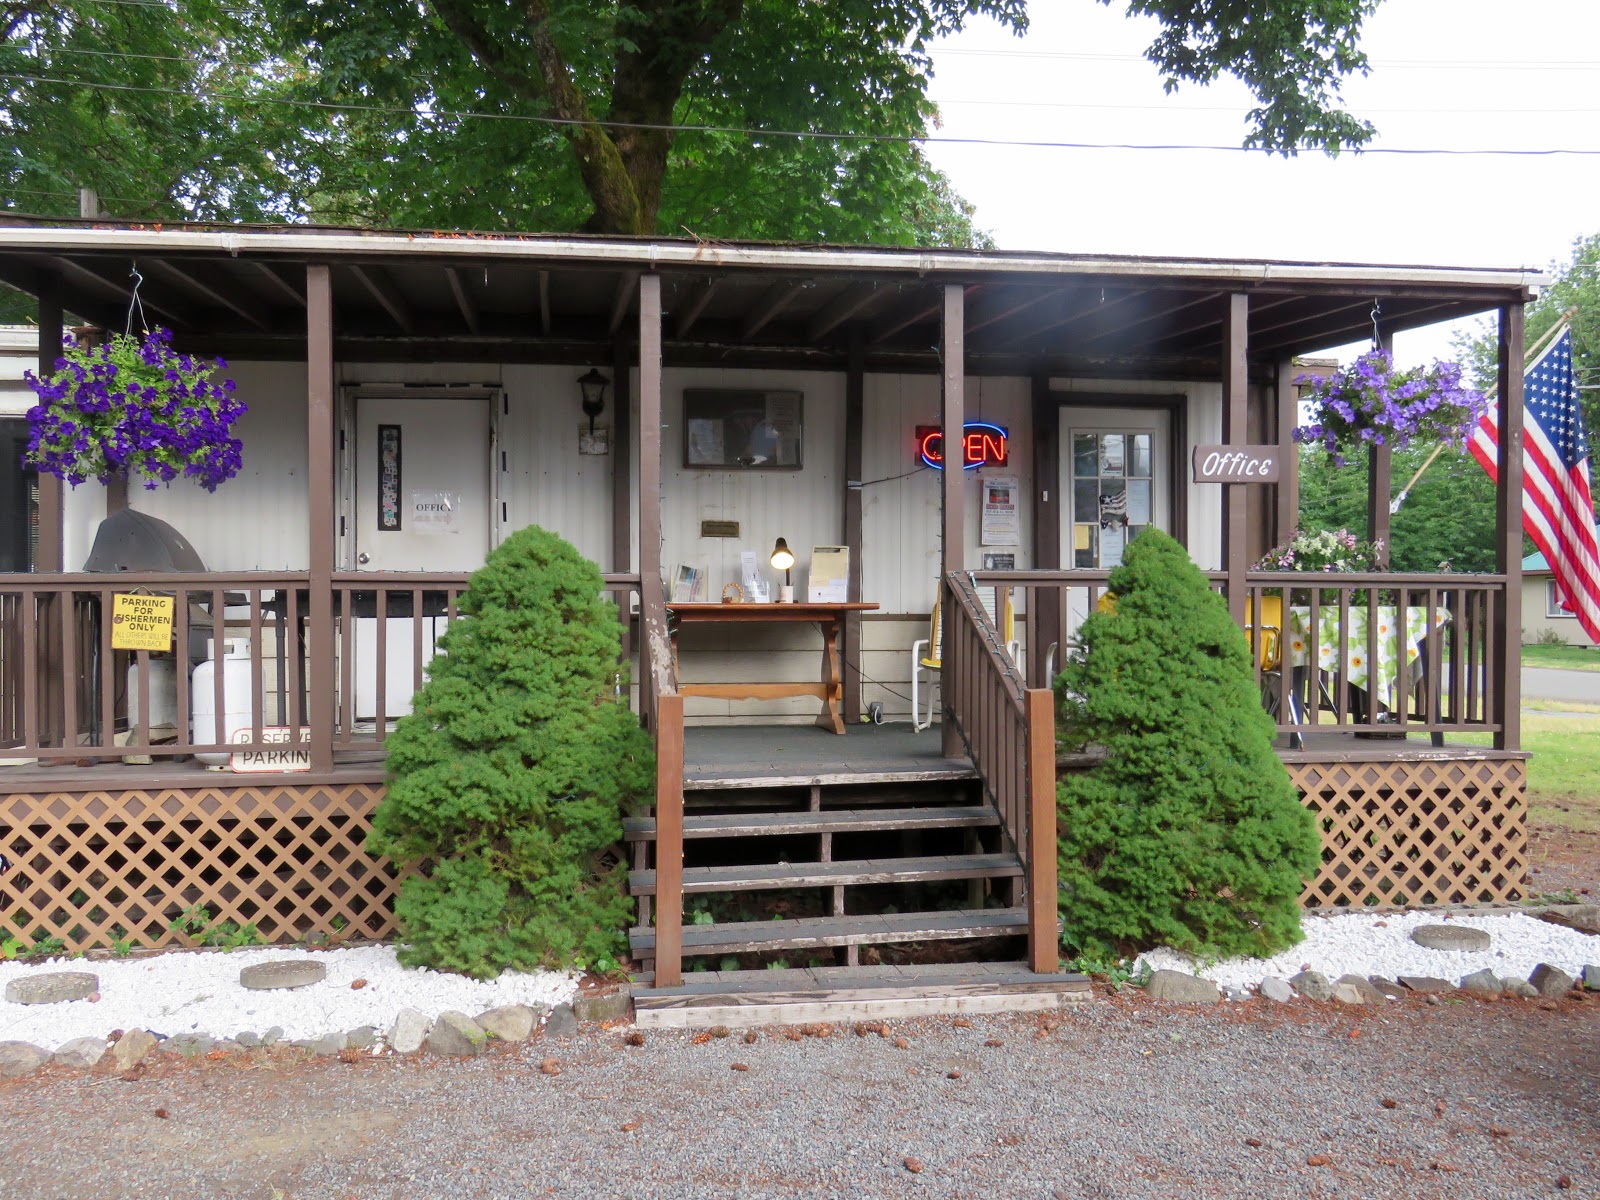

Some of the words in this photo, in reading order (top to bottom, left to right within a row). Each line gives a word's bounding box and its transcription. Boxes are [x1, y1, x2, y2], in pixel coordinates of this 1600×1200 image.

[922, 433, 1004, 461] OEN
[1202, 452, 1272, 476] Office
[122, 598, 166, 608] PARKING
[134, 607, 153, 615] FOR
[115, 613, 170, 624] FISHERMEN
[129, 623, 155, 631] ONLY
[149, 632, 160, 640] WILL
[161, 633, 169, 641] BE
[120, 639, 146, 647] THROWN
[243, 750, 308, 765] PARKIN
